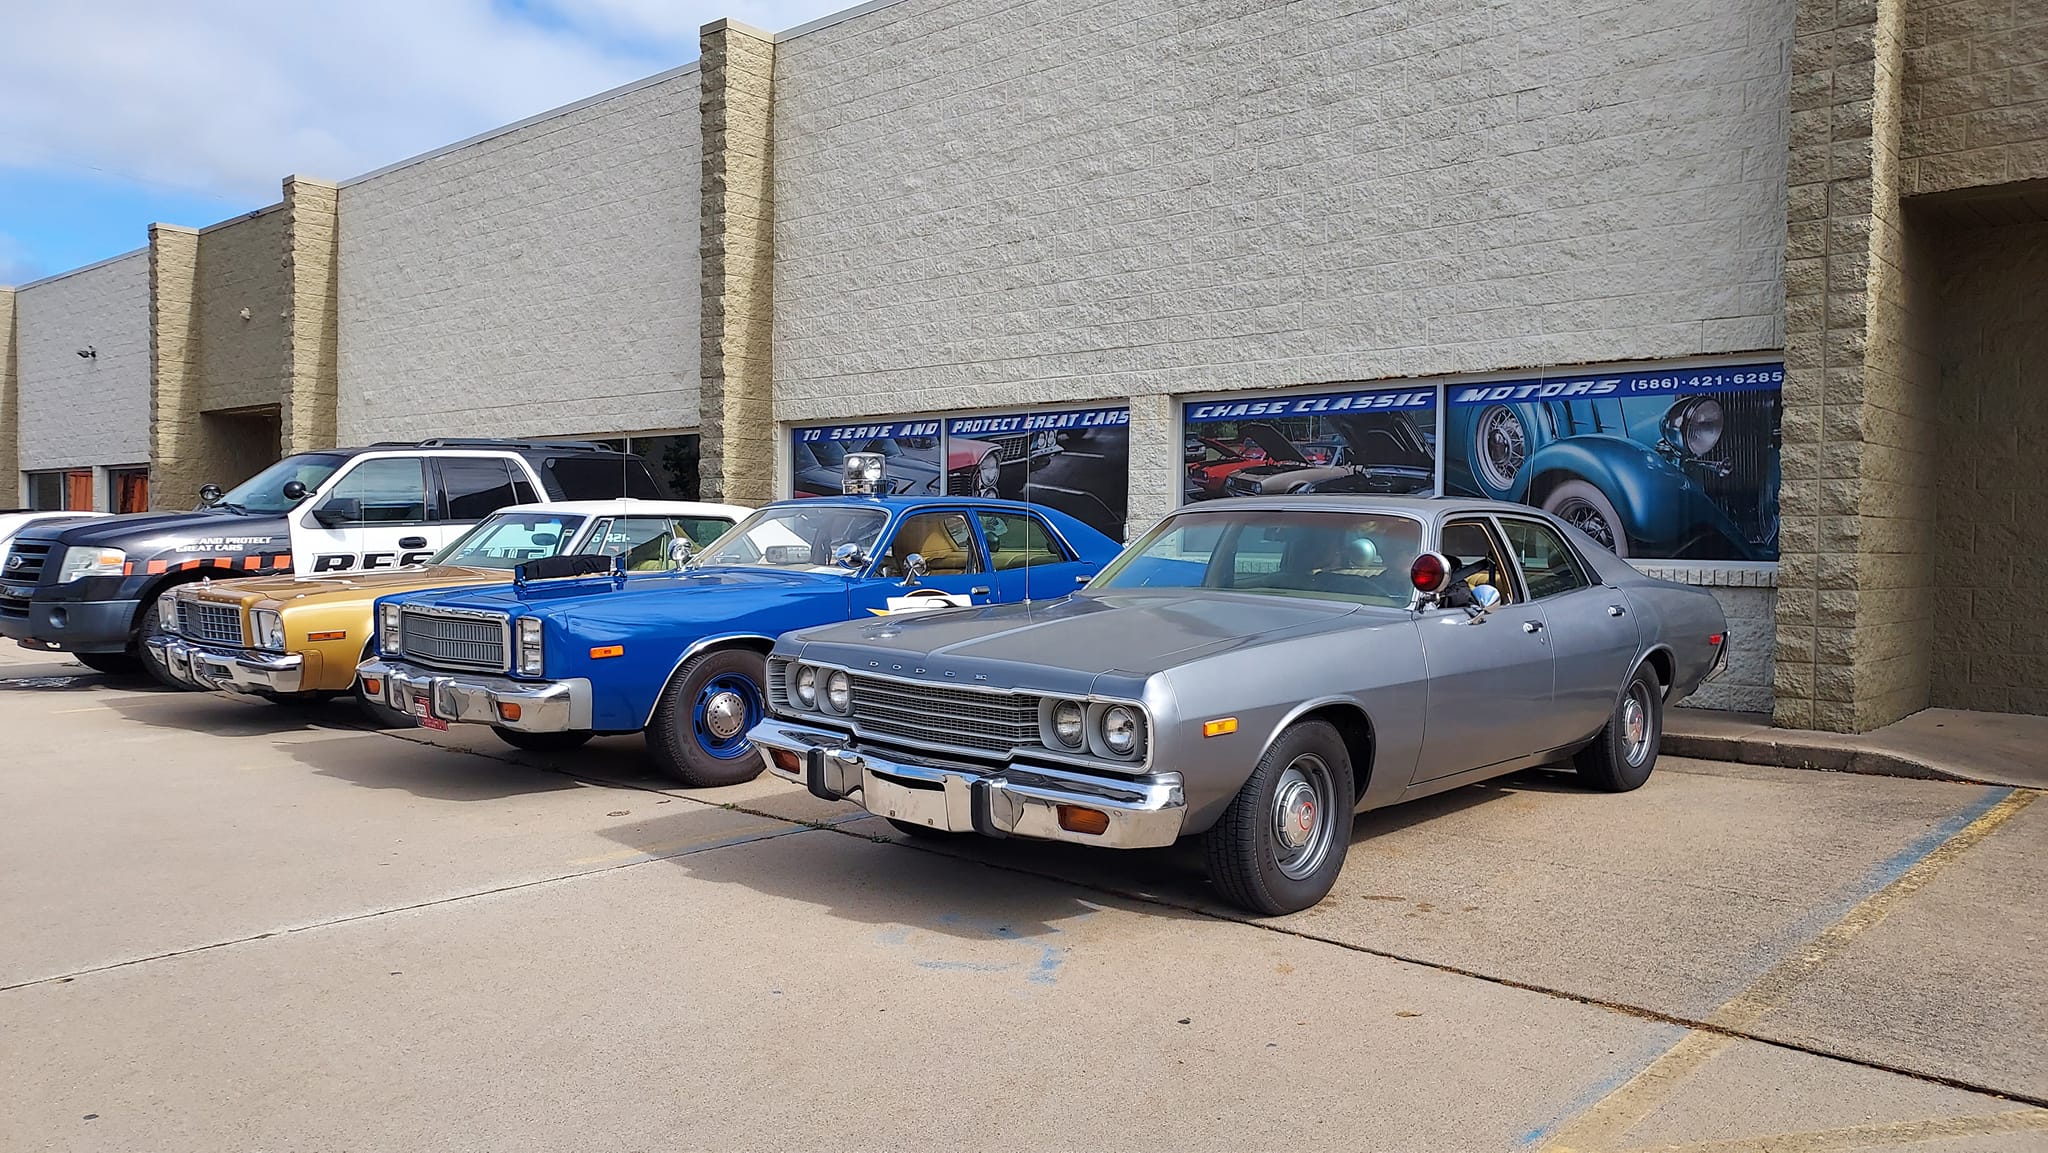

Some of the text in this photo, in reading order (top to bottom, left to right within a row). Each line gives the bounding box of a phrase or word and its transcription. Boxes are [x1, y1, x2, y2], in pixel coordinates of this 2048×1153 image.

[1192, 379, 1621, 419] CHASE CLASSIC MOTORS
[803, 411, 1129, 441] TO SERVE AND PROTECT GREAT CARS
[176, 544, 244, 553] GREAT CARS
[199, 536, 223, 545] AND
[224, 536, 272, 545] PROTECT
